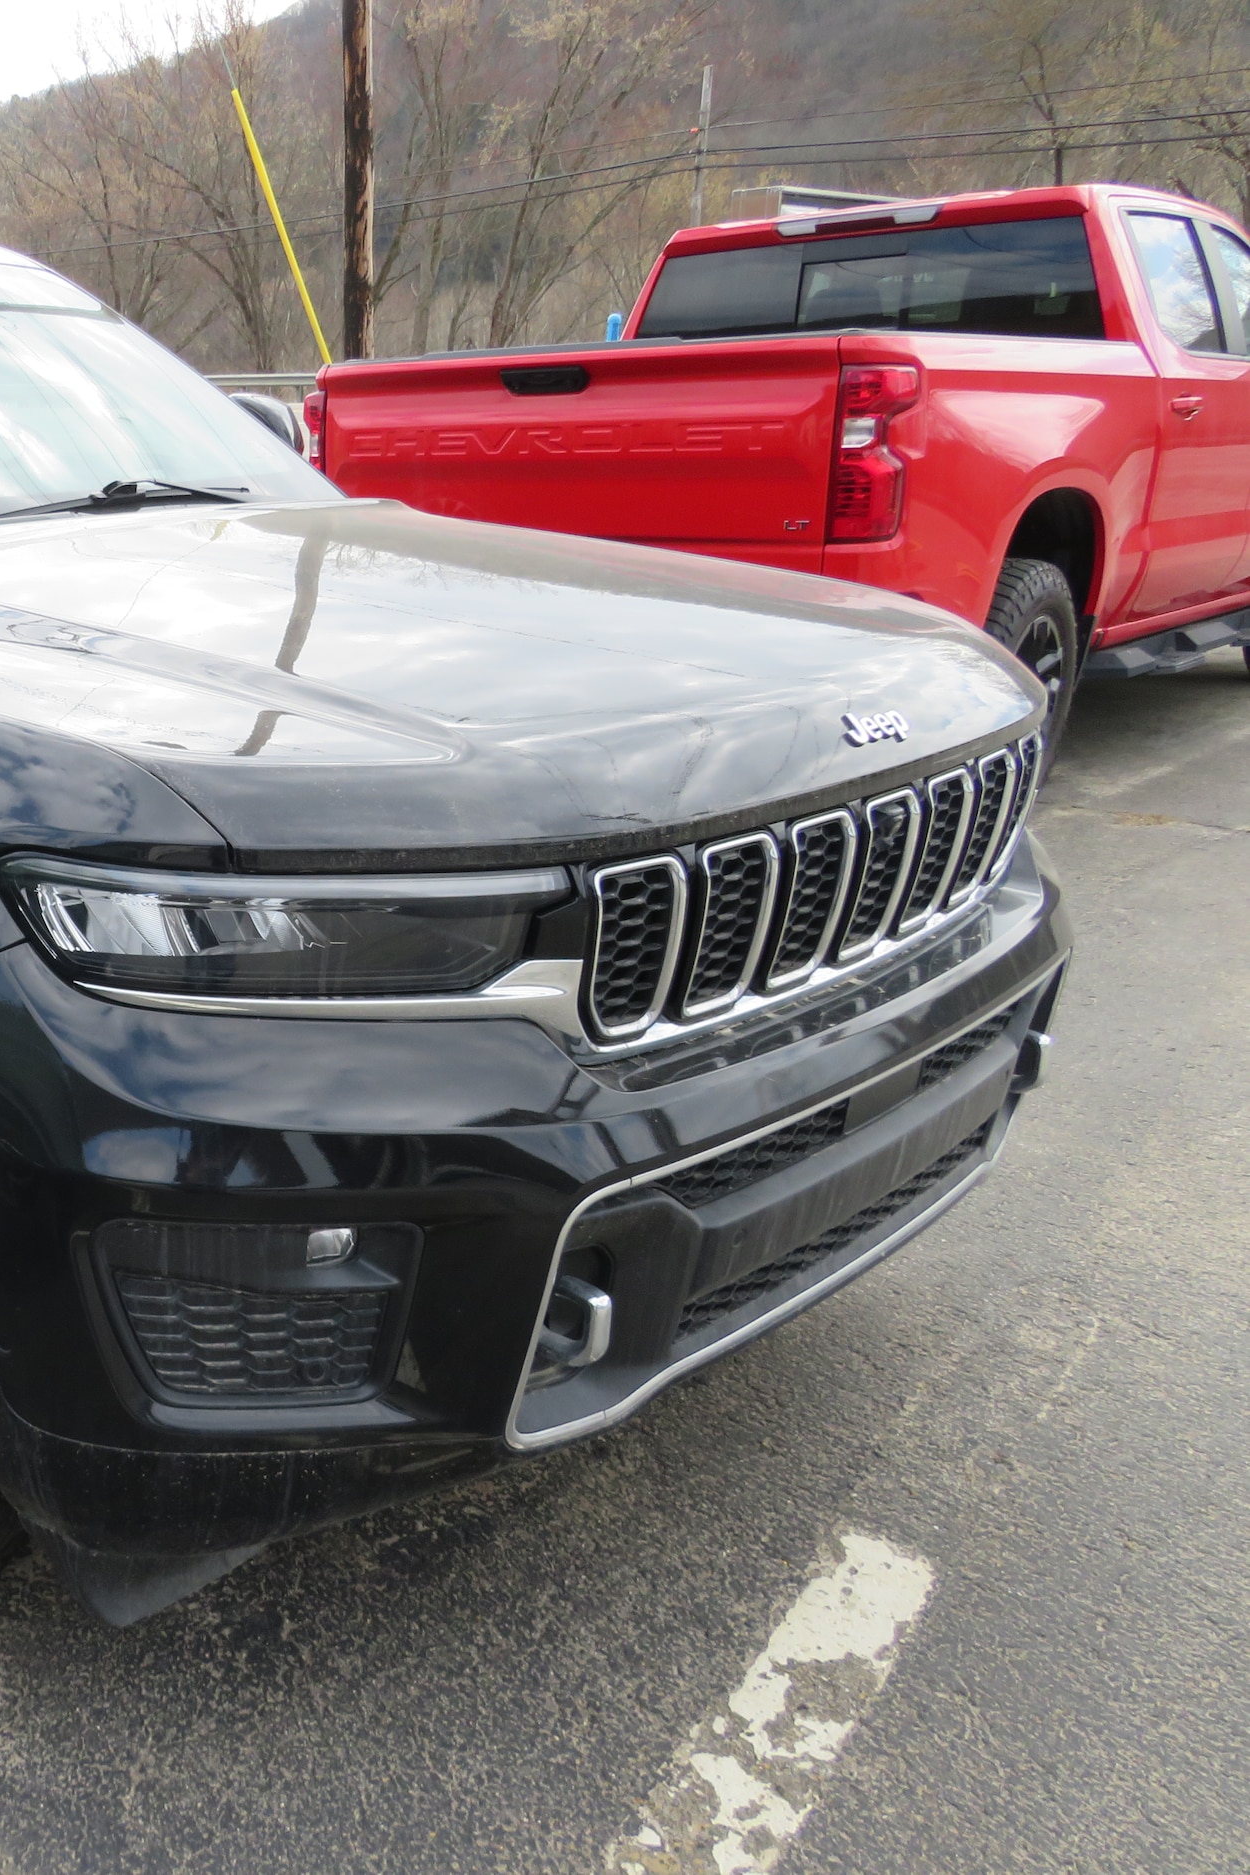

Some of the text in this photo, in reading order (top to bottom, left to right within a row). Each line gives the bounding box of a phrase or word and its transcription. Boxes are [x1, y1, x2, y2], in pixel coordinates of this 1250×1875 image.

[348, 418, 785, 457] CHEVROLET
[783, 519, 811, 531] LT
[841, 709, 910, 747] Jeep
